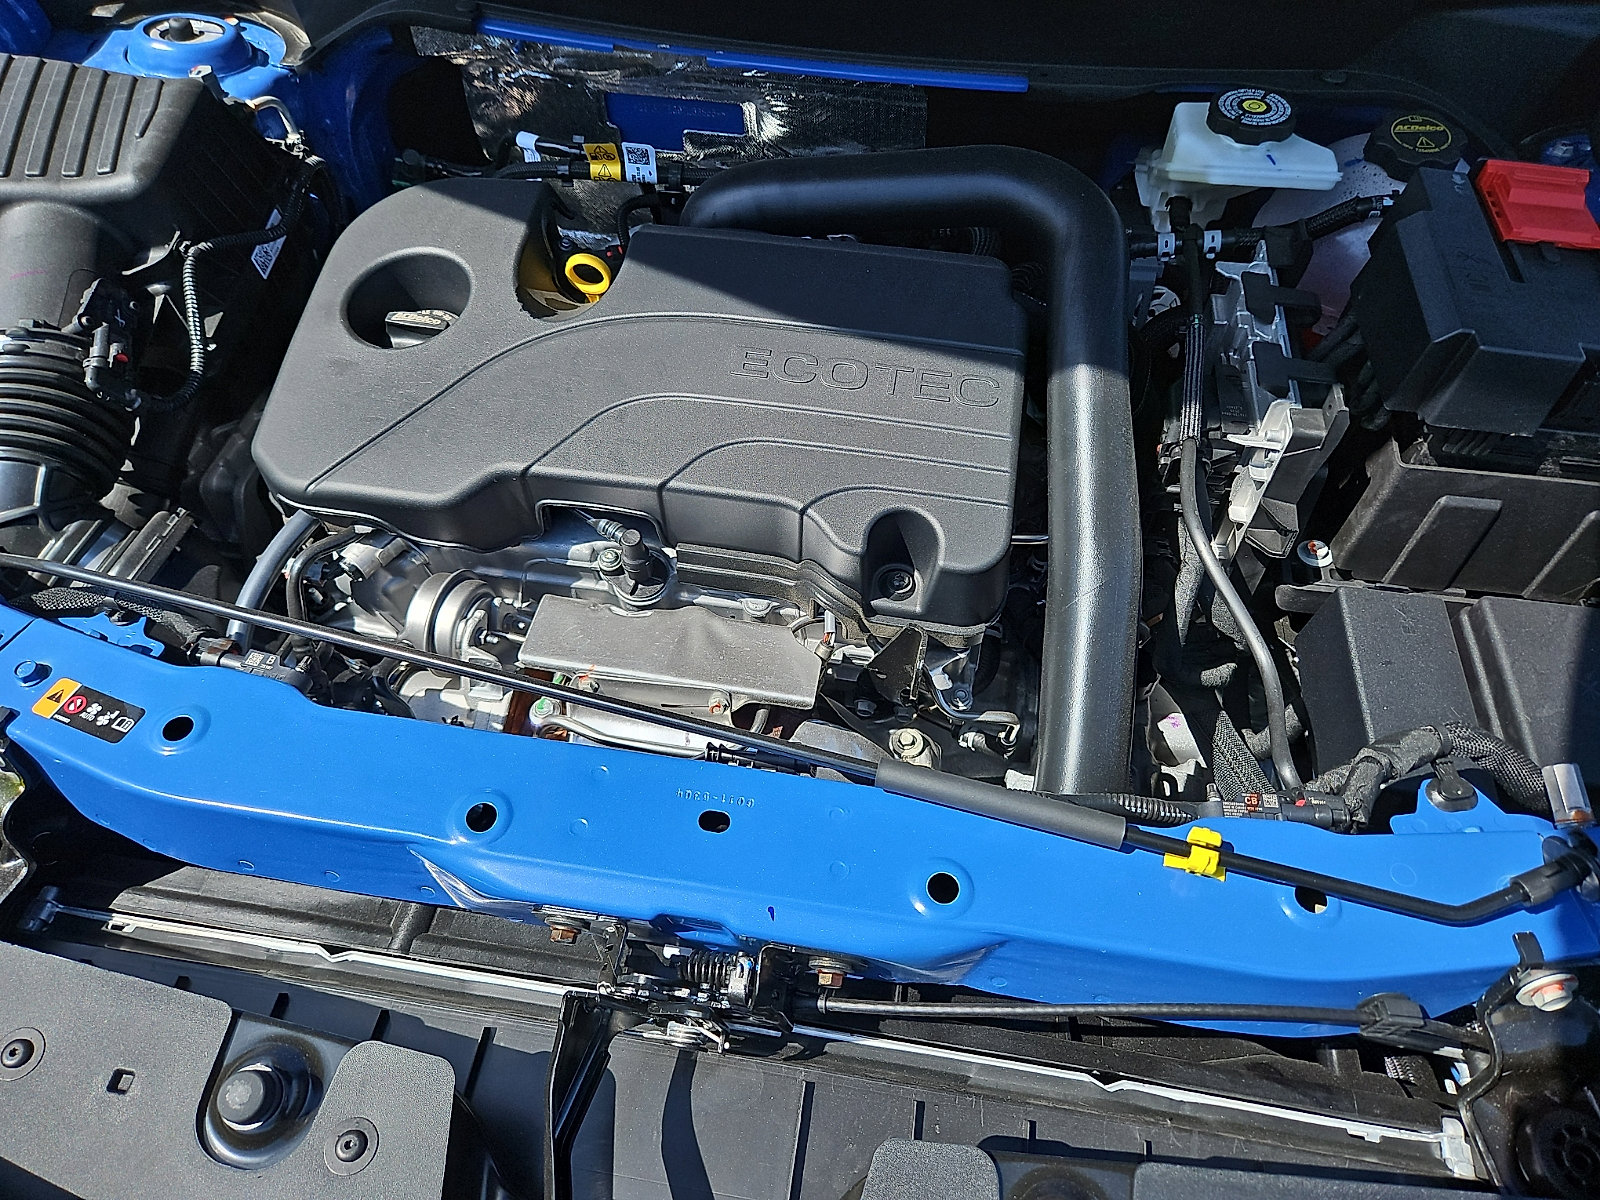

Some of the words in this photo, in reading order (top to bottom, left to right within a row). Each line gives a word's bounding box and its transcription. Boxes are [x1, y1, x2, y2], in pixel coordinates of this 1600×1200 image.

[1394, 124, 1445, 133] ACDelco
[391, 312, 442, 326] ACDelco
[730, 347, 1001, 408] ECOTEC
[79, 711, 96, 722] AUTO
[1244, 796, 1258, 805] CB
